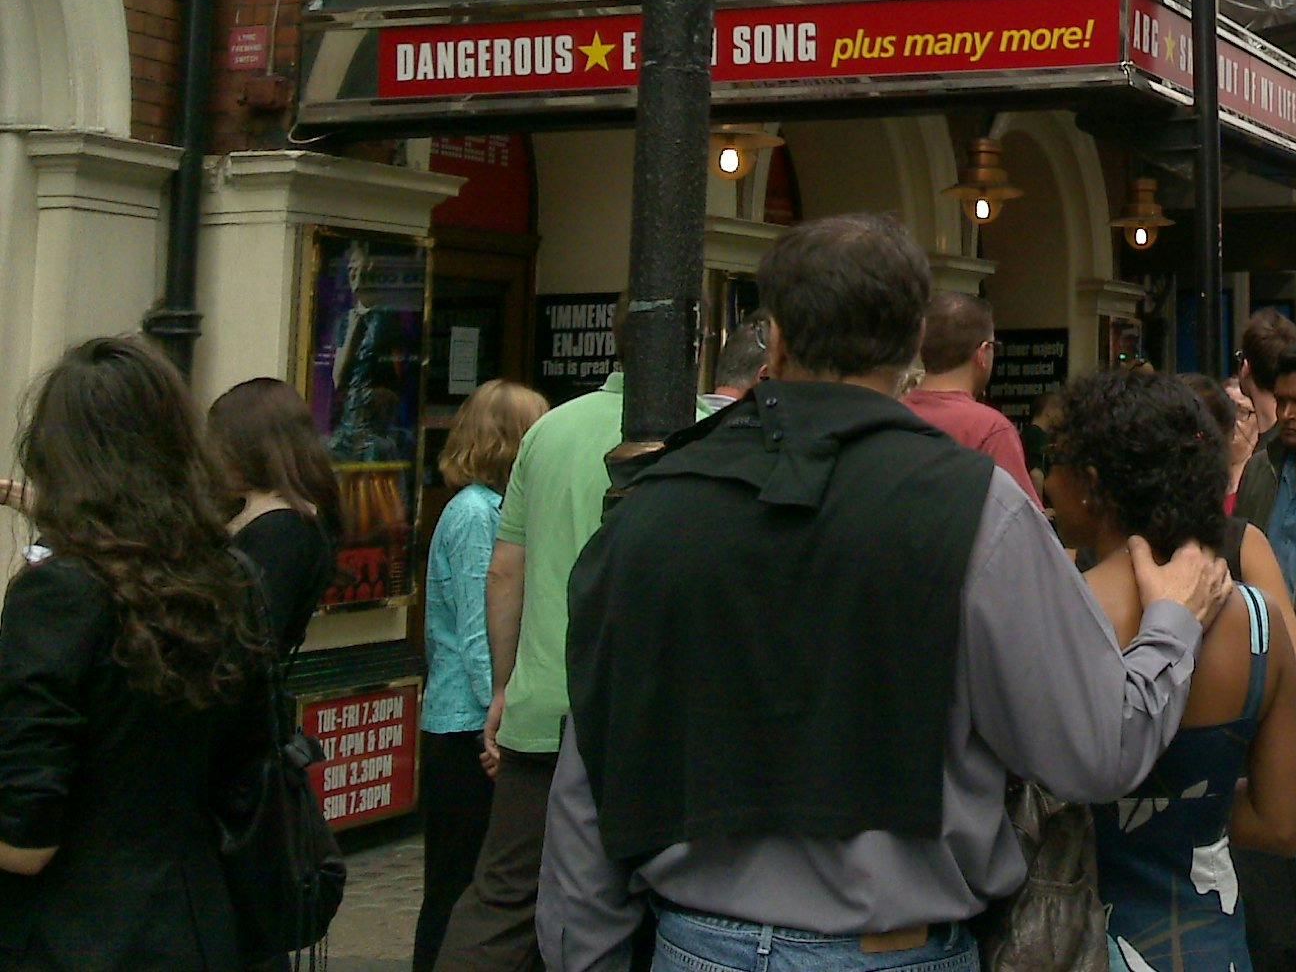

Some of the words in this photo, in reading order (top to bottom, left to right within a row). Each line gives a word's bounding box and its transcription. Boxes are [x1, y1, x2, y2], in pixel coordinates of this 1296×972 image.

[732, 22, 817, 65] SONG
[831, 28, 896, 68] plus
[903, 29, 994, 62] many
[999, 19, 1095, 52] more!
[1133, 10, 1159, 58] ABC
[396, 34, 574, 82] DANGEROUS
[1243, 68, 1256, 105] OF
[1260, 77, 1274, 113] MY
[1278, 85, 1296, 124] LIFE
[545, 303, 617, 329] 'IMMENS
[542, 360, 564, 376] This
[567, 360, 577, 375] is
[580, 359, 609, 378] great
[318, 704, 360, 733] TUE-FRI
[361, 696, 403, 725] 7.30PM
[320, 737, 337, 761] AT
[339, 732, 365, 757] 4PM
[368, 730, 376, 752] &
[378, 725, 403, 749] 8PM
[323, 763, 347, 791] SUN
[350, 754, 393, 785] 3.30PM
[323, 793, 347, 821] SUN
[349, 783, 391, 814] 7.30PM
